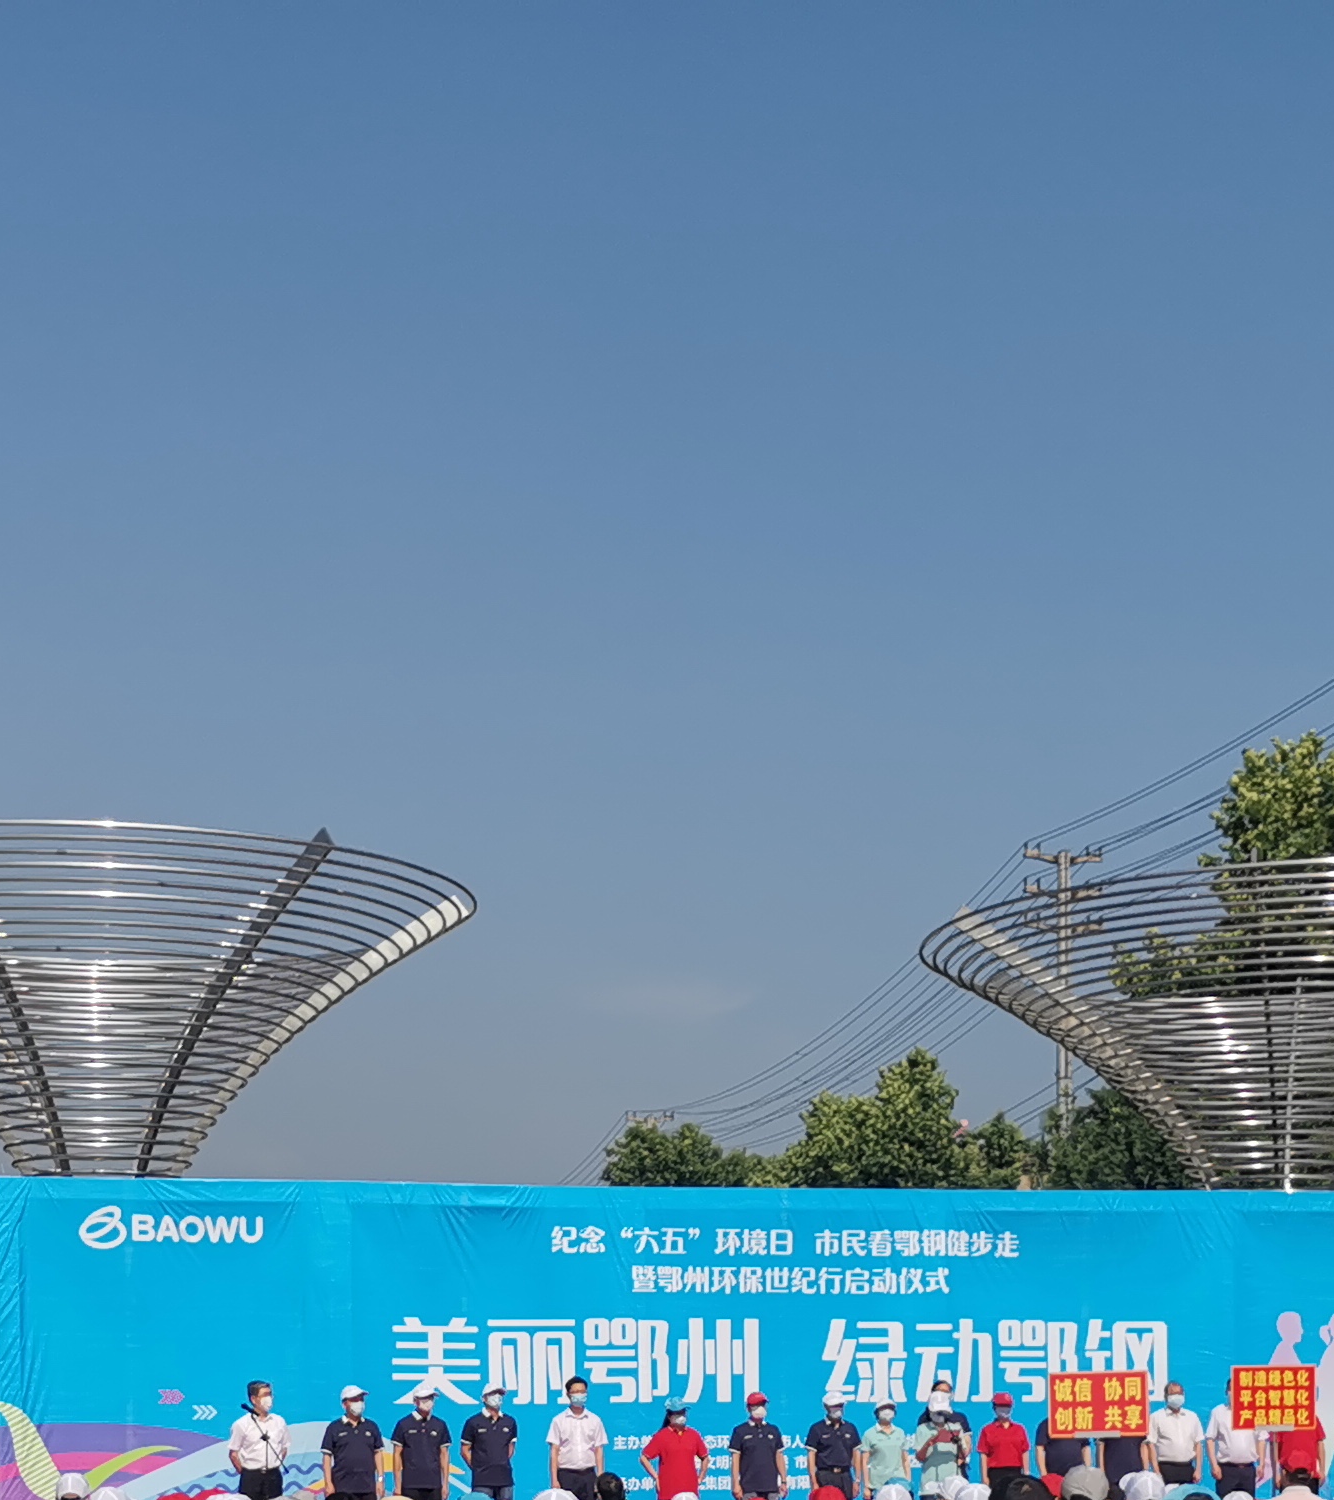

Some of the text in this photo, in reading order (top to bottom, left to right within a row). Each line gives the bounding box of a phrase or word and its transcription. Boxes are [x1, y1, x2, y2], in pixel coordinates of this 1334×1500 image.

[131, 1213, 264, 1244] BAOWU
[550, 1225, 607, 1254] 纪念
[714, 1228, 794, 1257] 环境日
[813, 1228, 1020, 1259] 市民看鄂钢健步走
[631, 1264, 951, 1295] 暨鄂州环保世纪行启动仪式
[392, 1316, 1169, 1406] 美丽鄂州 绿动鄂钢
[1053, 1376, 1142, 1403] 诚信 协同
[1238, 1369, 1311, 1387] 制造绿色化
[1238, 1389, 1310, 1408] 平台智慧化
[1054, 1404, 1144, 1432] 创新 共享
[1238, 1408, 1310, 1426] 产品精品化
